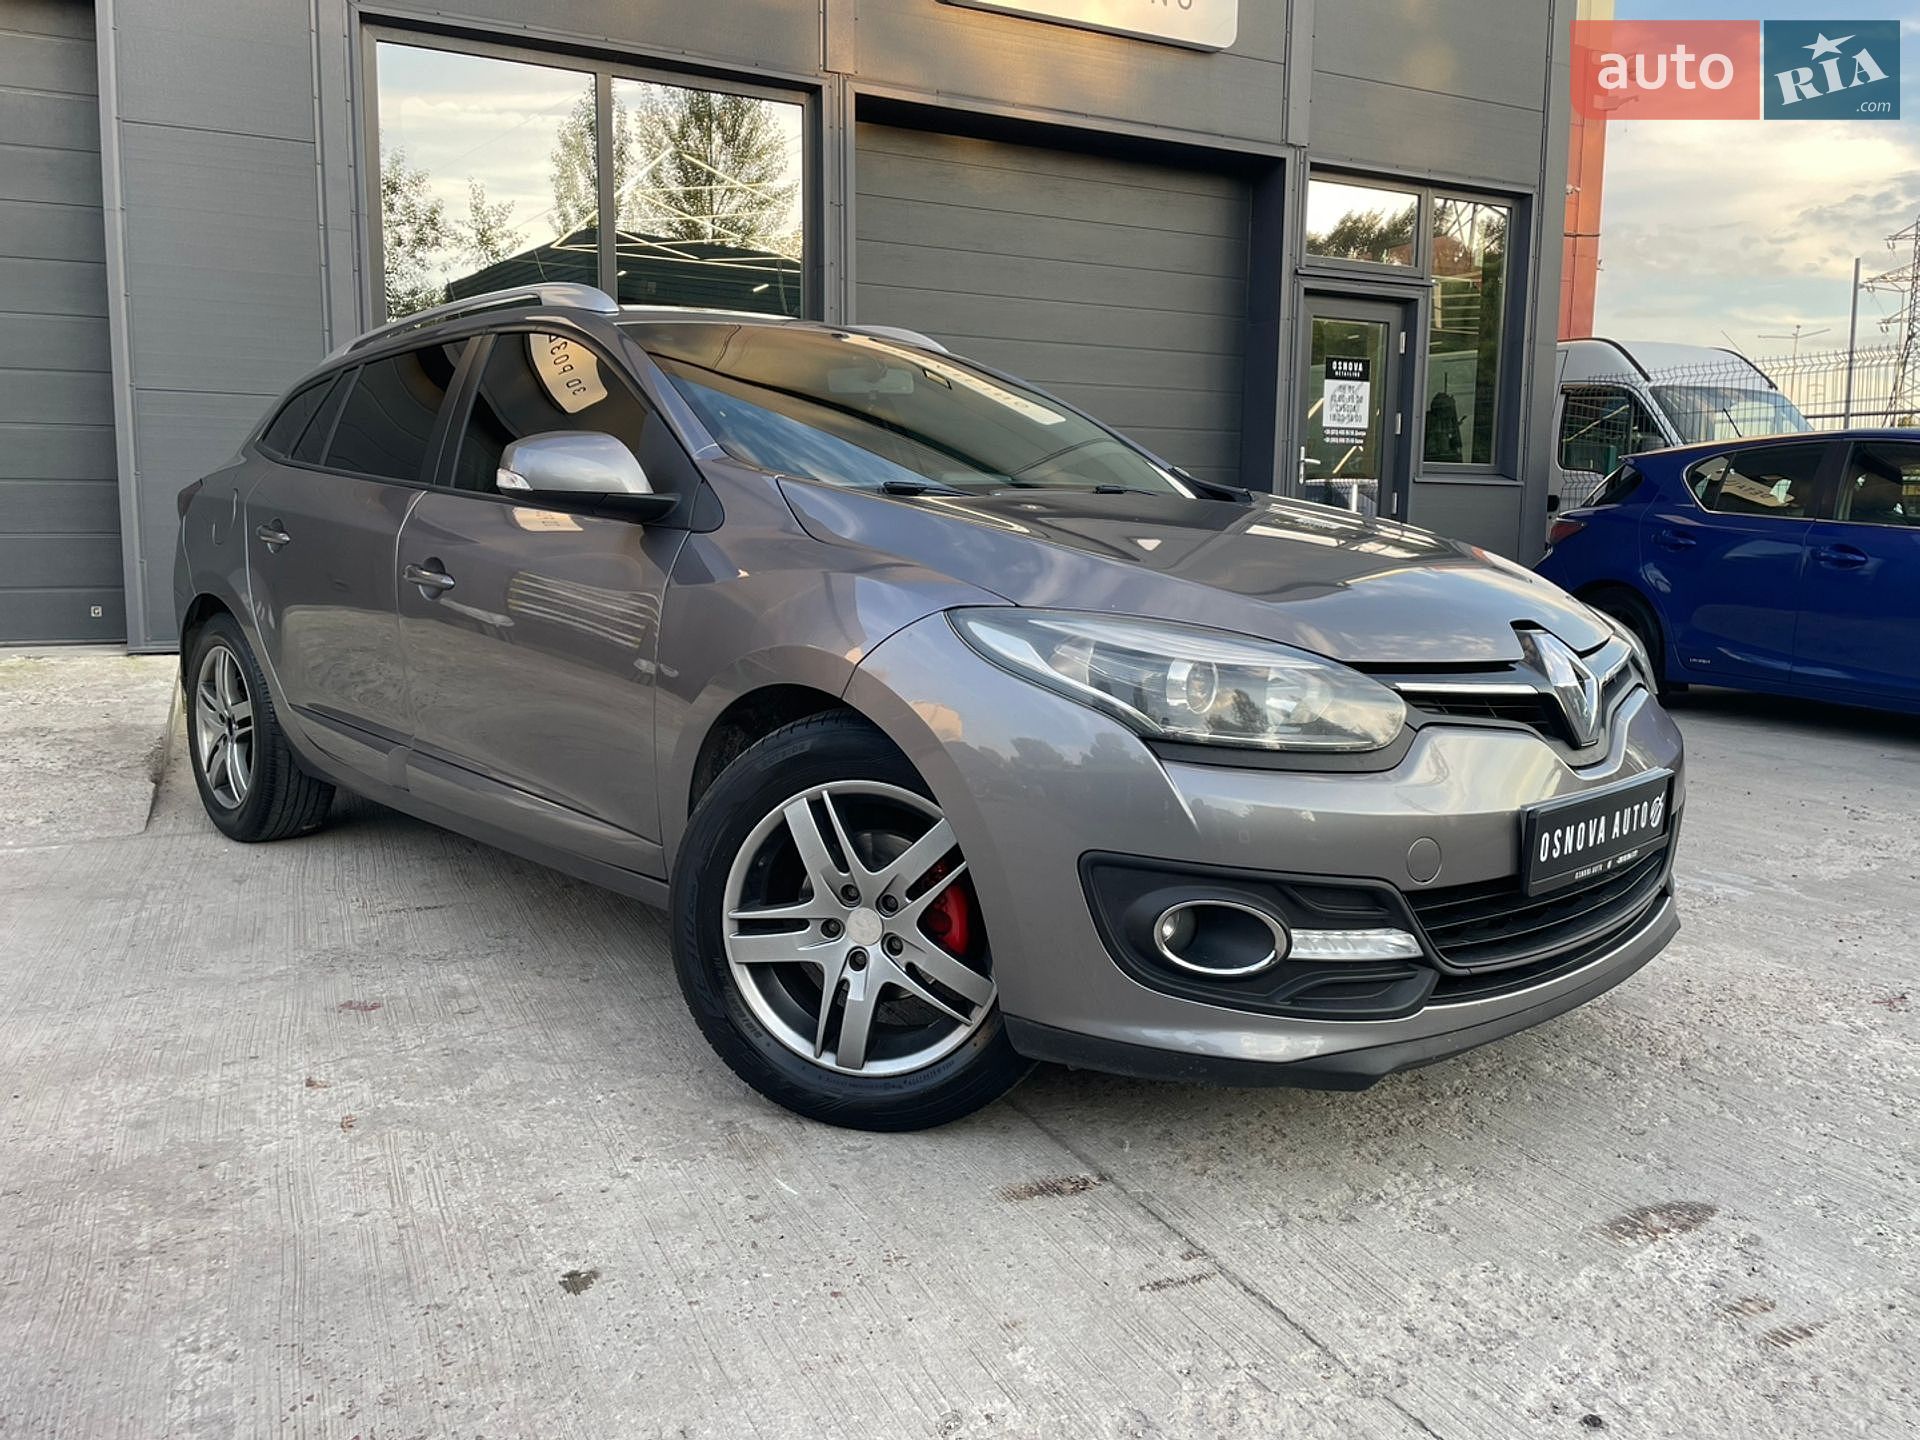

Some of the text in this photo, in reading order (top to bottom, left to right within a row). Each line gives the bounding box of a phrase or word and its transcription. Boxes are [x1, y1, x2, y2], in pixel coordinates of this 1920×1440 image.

[1331, 360, 1364, 372] OSNOVA
[1539, 800, 1649, 862] OSNOVA AUTO
